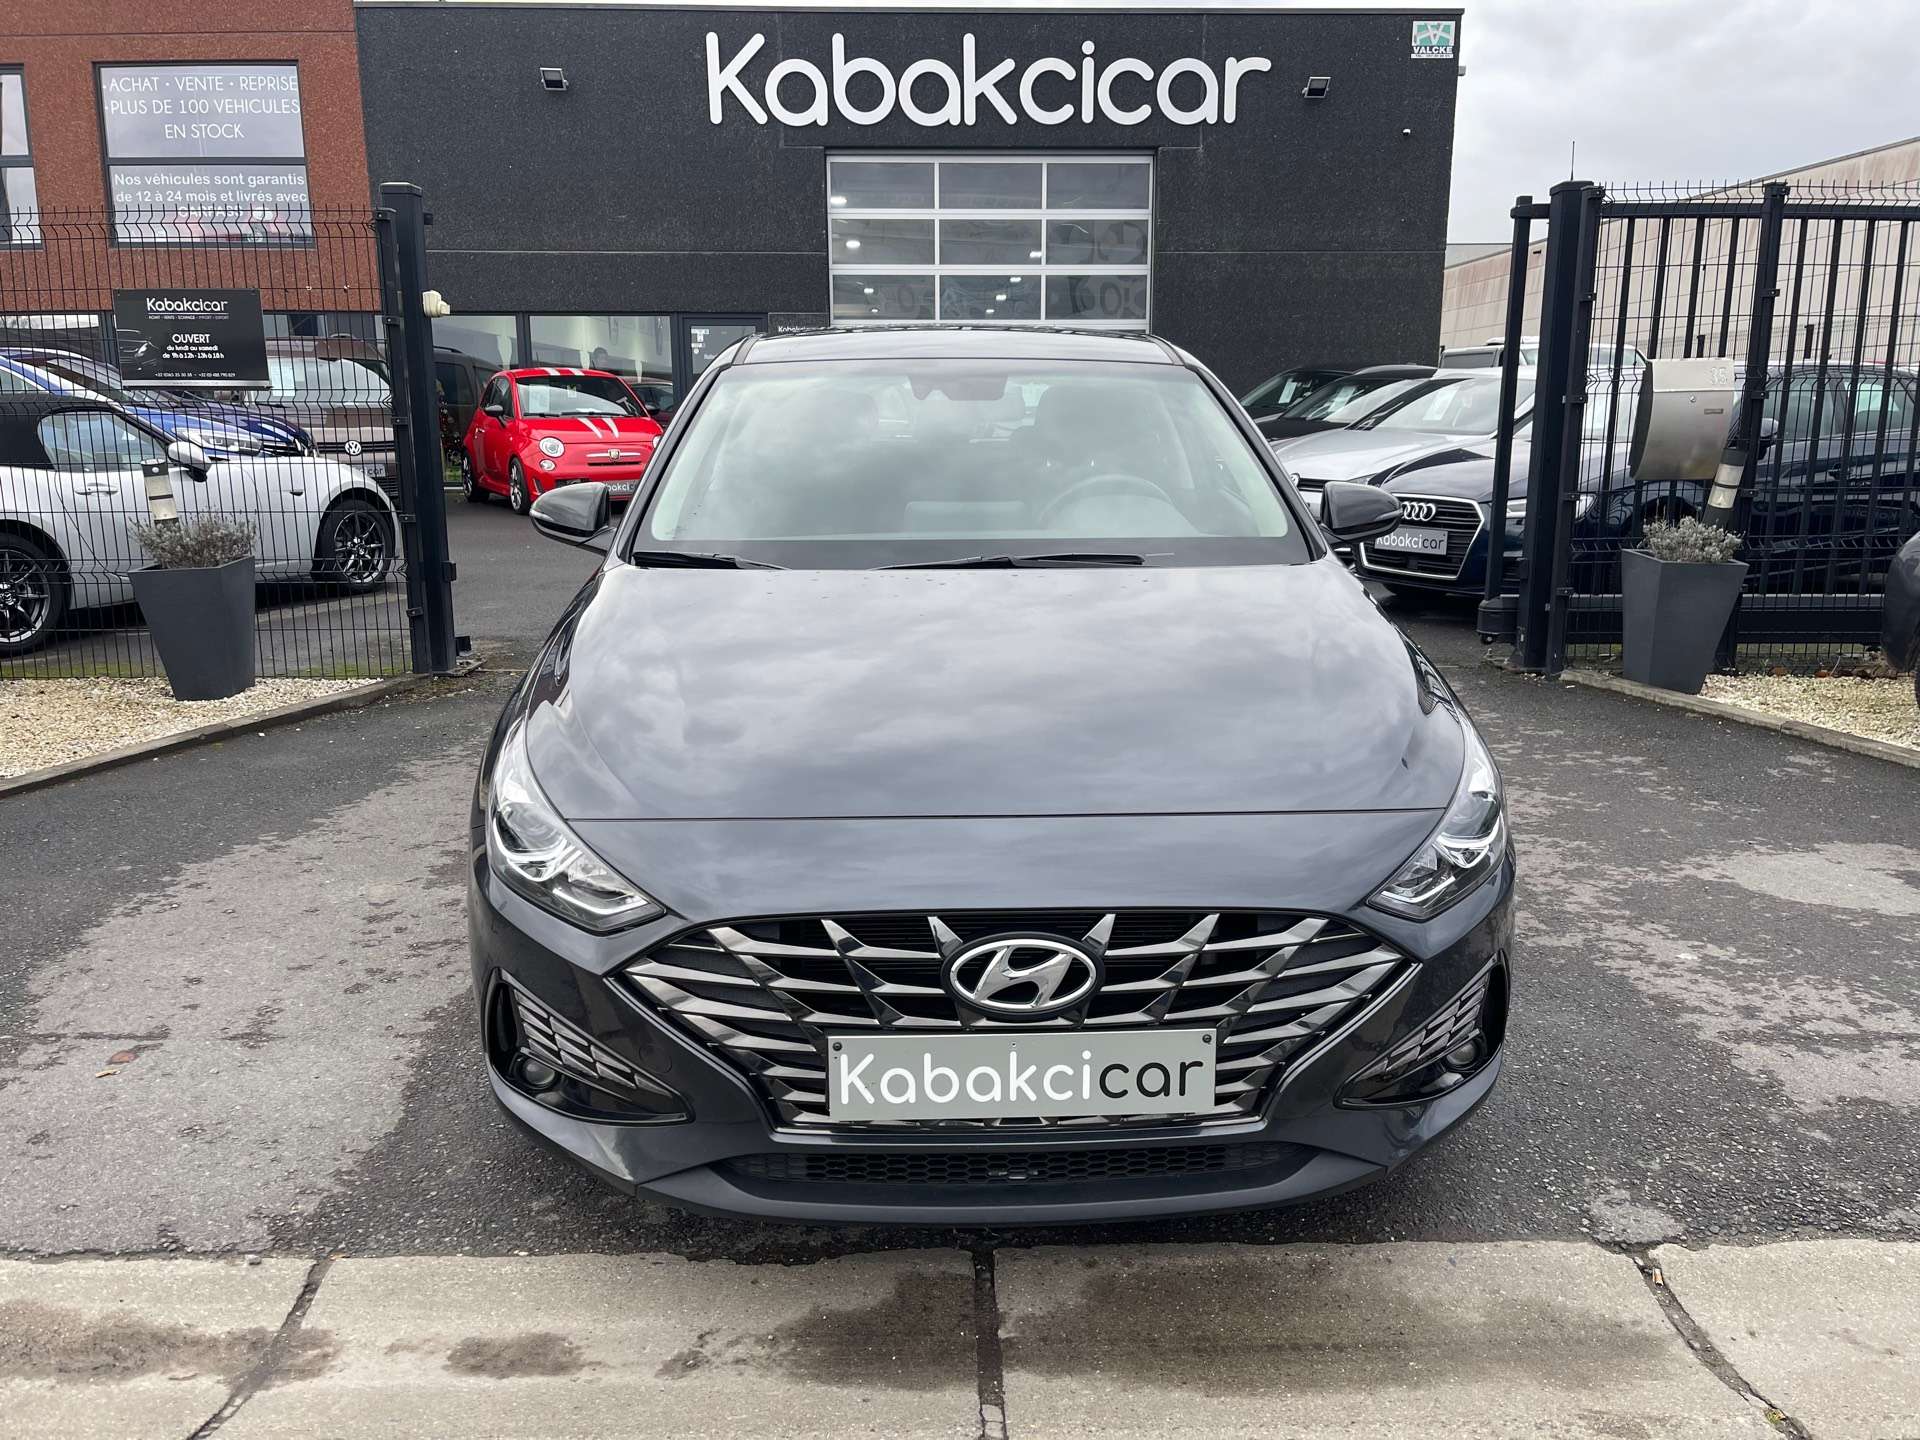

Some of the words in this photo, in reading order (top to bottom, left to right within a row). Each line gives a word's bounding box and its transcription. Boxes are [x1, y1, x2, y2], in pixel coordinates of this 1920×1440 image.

[1413, 46, 1453, 54] VALCKE
[109, 76, 160, 92] ACHAT
[175, 76, 224, 92] VENTE
[240, 76, 297, 91] REPRISE
[706, 31, 1272, 127] Kabakcicar
[110, 100, 148, 114] PLUS
[153, 100, 172, 114] DE
[179, 99, 209, 114] 100
[214, 98, 300, 114] VEHICULES
[165, 124, 186, 139] EN
[191, 123, 245, 139] STOCK
[114, 174, 141, 185] Nos
[145, 173, 210, 185] véhicules
[214, 174, 245, 185] sont
[248, 173, 305, 188] garantis
[116, 191, 133, 202] de
[137, 191, 151, 202] 12
[154, 190, 163, 202] à
[166, 191, 182, 202] 24
[186, 191, 217, 202] mois
[220, 191, 233, 202] et
[237, 190, 273, 202] livrés
[276, 193, 307, 202] avec
[146, 297, 228, 312] Kabakcicar
[172, 333, 210, 344] OUVERT
[1710, 366, 1727, 385] 35
[839, 1050, 1204, 1105] Kabakcicar
